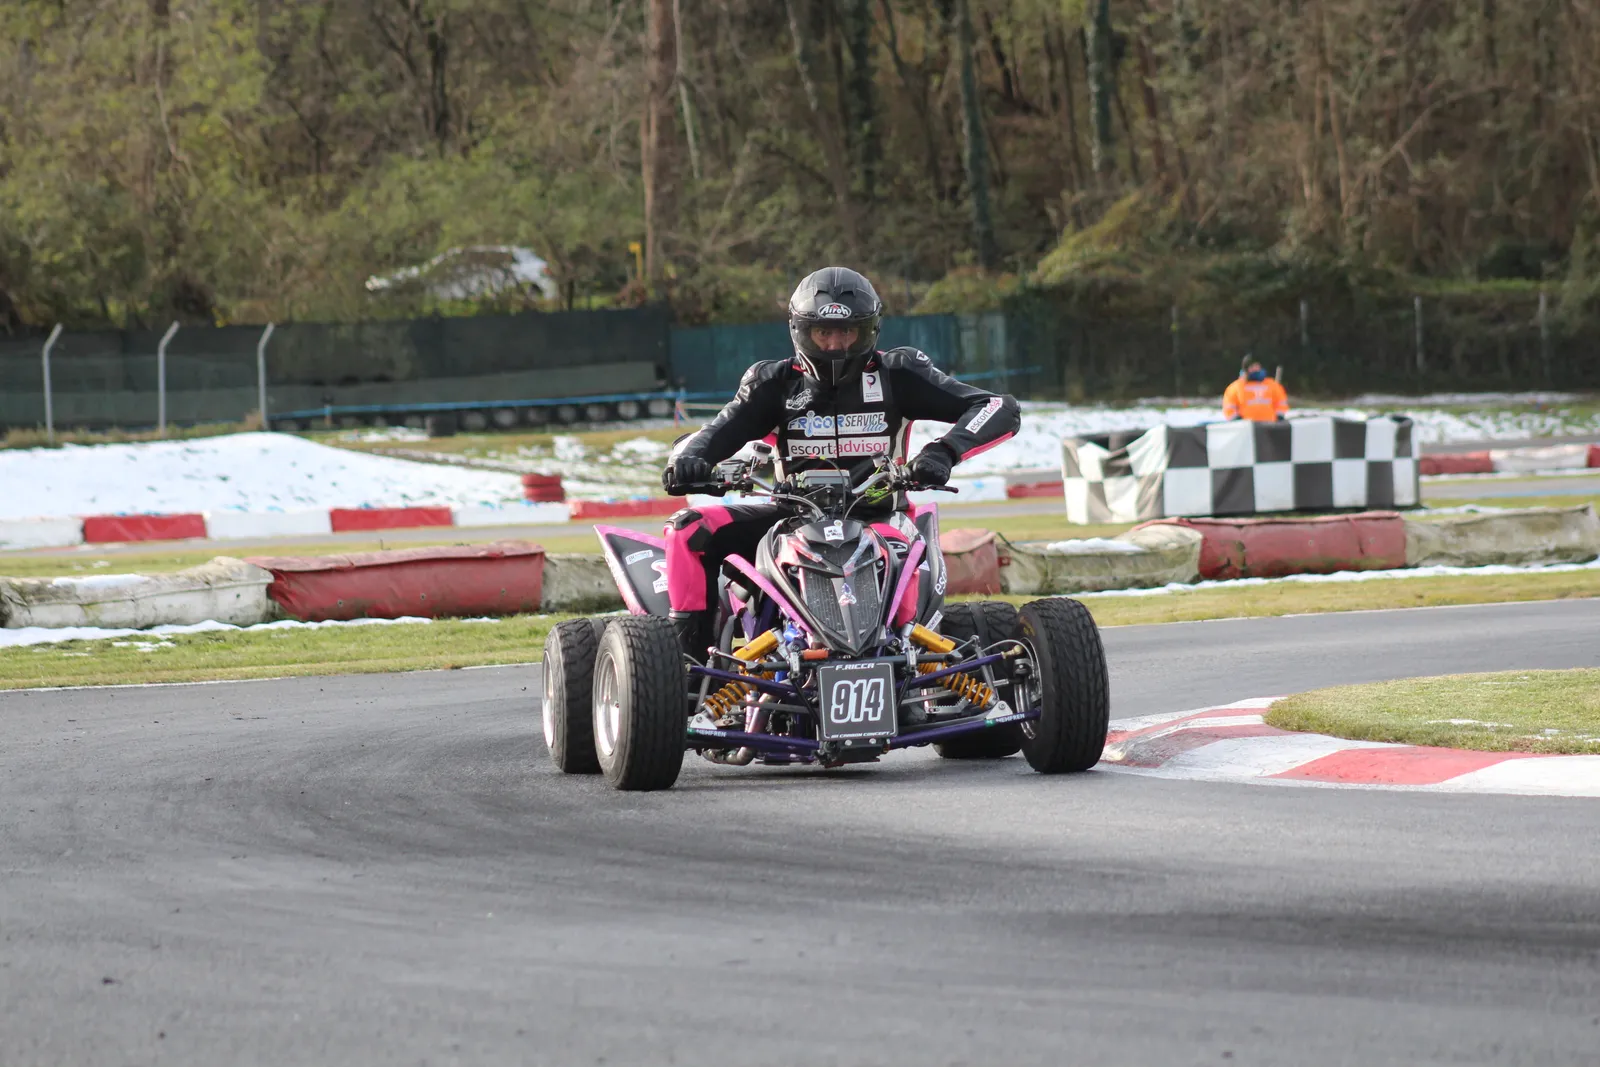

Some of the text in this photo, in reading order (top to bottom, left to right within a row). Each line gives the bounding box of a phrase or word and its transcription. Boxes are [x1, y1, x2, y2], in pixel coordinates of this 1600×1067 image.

[820, 304, 849, 316] Airoh
[844, 413, 884, 427] SERVICE
[830, 678, 885, 723] 914
